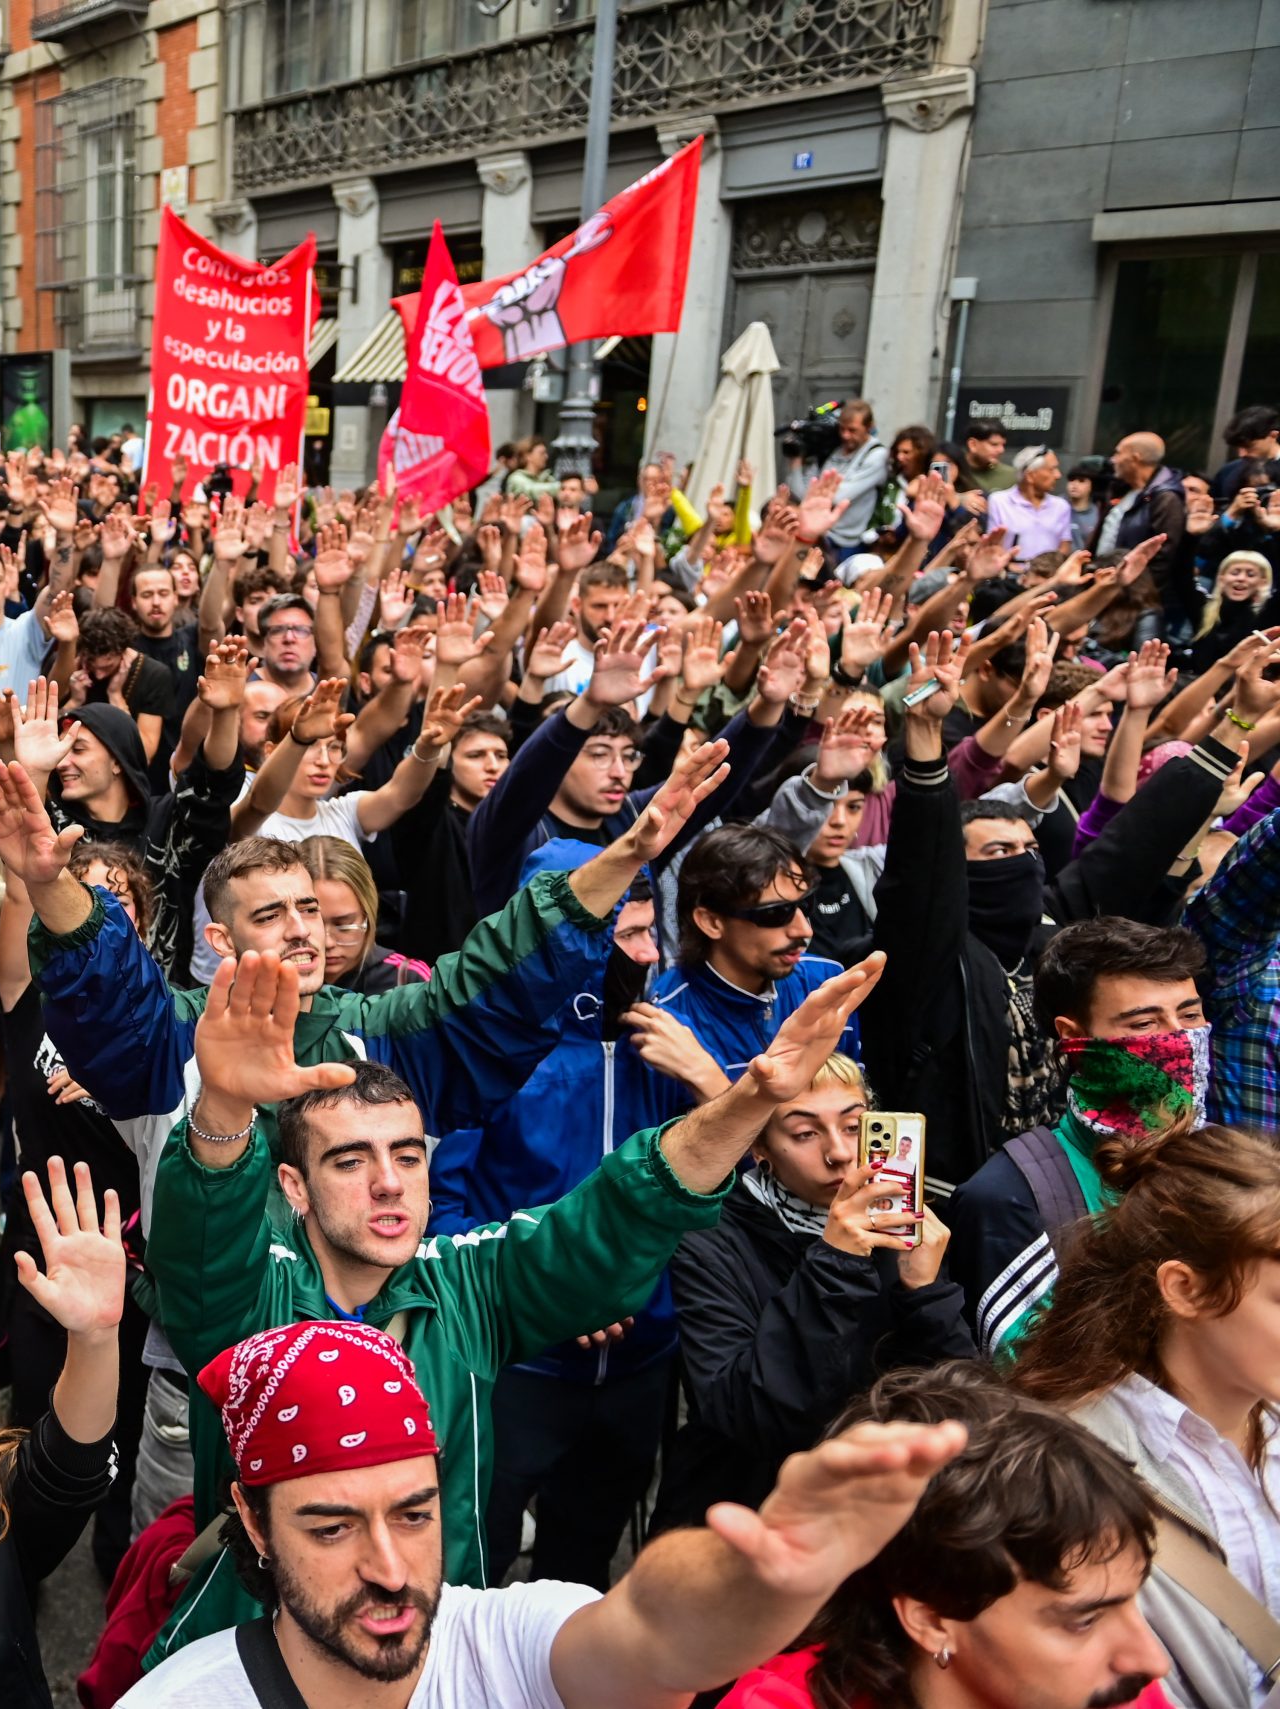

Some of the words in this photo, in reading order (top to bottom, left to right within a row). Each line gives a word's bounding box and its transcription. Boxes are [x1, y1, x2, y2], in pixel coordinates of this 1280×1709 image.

[174, 274, 292, 316] desahucios
[204, 318, 221, 343] y
[225, 317, 246, 343] la
[164, 336, 301, 374] especulación
[167, 373, 288, 421] ORGANI
[1038, 407, 1053, 431] 19
[163, 423, 281, 471] ZACIÓN
